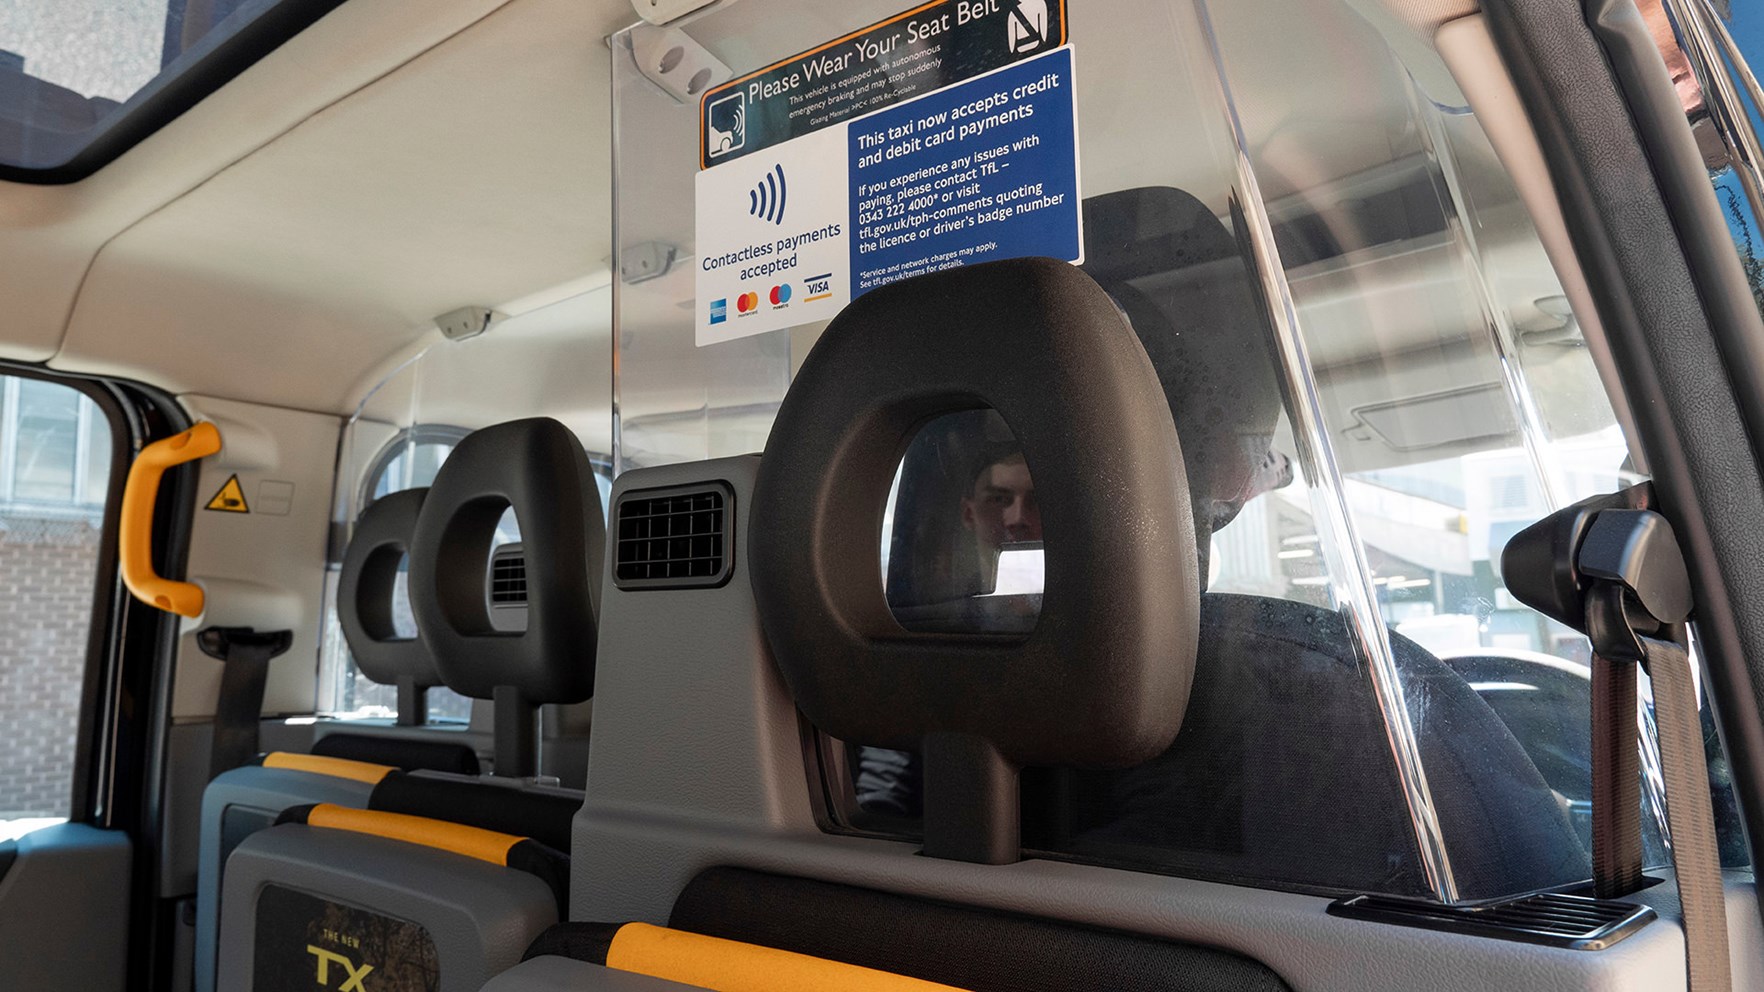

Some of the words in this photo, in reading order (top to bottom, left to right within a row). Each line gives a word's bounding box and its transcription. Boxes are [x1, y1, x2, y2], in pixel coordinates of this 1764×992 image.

[748, 73, 800, 105] Please
[802, 52, 853, 82] Wear
[855, 33, 901, 62] Your
[907, 13, 950, 44] Seat
[957, 0, 1000, 26] Belt
[789, 95, 804, 105] This
[804, 85, 829, 100] vehicle
[830, 81, 837, 90] is
[838, 69, 872, 86] equipped
[873, 62, 890, 74] with
[891, 44, 942, 68] autonomous
[788, 101, 826, 119] emergency
[828, 90, 855, 106] braking
[856, 83, 870, 94] and
[871, 78, 887, 90] may
[888, 71, 906, 84] stop
[907, 57, 942, 77] suddenly
[857, 131, 885, 150] This
[888, 120, 914, 140] taxi
[917, 111, 947, 131] now
[951, 91, 1009, 120] accepts
[1012, 73, 1060, 100] credit
[869, 95, 884, 105] 100%
[858, 148, 882, 169] and
[885, 137, 922, 160] debit
[924, 125, 955, 147] card
[959, 104, 1034, 141] payments
[858, 184, 867, 196] If
[868, 181, 887, 196] you
[889, 163, 948, 187] experience
[950, 156, 971, 170] any
[973, 144, 1010, 163] issues
[1012, 134, 1040, 152] with
[859, 193, 895, 214] paying,
[897, 182, 932, 203] please
[934, 168, 978, 190] contact
[980, 161, 999, 177] TfL
[859, 208, 884, 225] 0343
[886, 202, 905, 218] 222
[941, 191, 954, 203] or
[956, 182, 981, 199] visit
[859, 196, 993, 239] tfl.gov.uk/tph-comments
[995, 182, 1043, 206] quoting
[859, 241, 877, 254] the
[879, 231, 917, 249] licence
[919, 228, 931, 239] or
[977, 206, 1013, 225] badge
[1016, 193, 1065, 215] number
[702, 242, 773, 272] Contactless
[776, 223, 841, 255] payments
[740, 252, 798, 280] accepted
[887, 263, 900, 274] and
[900, 256, 929, 270] network
[930, 250, 958, 263] charges
[958, 246, 975, 256] may
[975, 241, 998, 253] apply.
[807, 280, 830, 295] VISA
[859, 280, 872, 289] See
[872, 267, 926, 286] tfl.gov.uk/terms
[926, 264, 937, 274] for
[938, 258, 965, 271] details.
[323, 928, 338, 942] THE
[341, 934, 361, 950] NEW
[306, 943, 375, 992] TX
